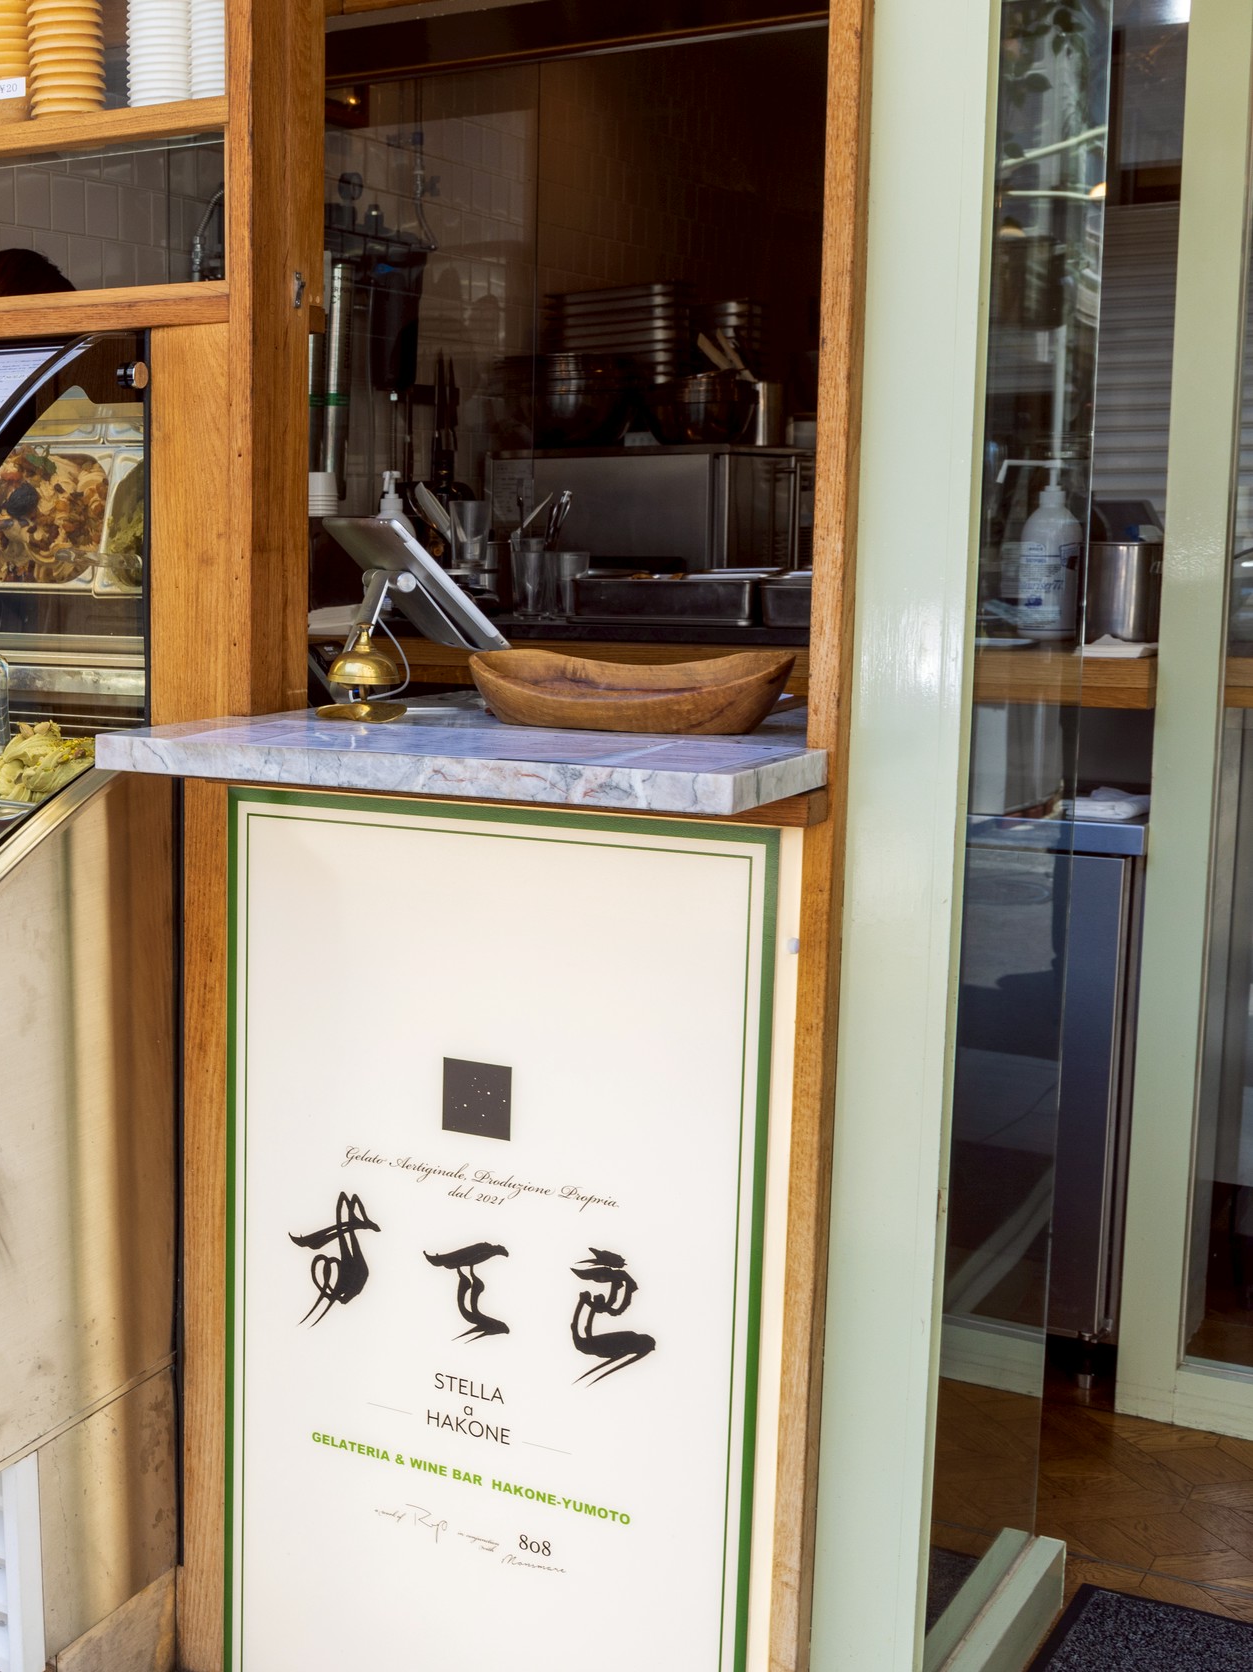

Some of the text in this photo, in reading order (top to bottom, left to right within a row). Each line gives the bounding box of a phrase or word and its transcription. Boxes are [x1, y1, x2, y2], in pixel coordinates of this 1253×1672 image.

[341, 1145, 388, 1168] Gelato
[472, 1168, 556, 1196] Produzione
[447, 1185, 506, 1206] dal 2021
[433, 1372, 505, 1405] STELLA
[426, 1409, 511, 1446] HAKONE
[463, 1405, 474, 1417] a
[311, 1431, 631, 1526] GELATERIA & WINE BAR HAKONE-YUMOTO
[519, 1534, 552, 1557] 808
